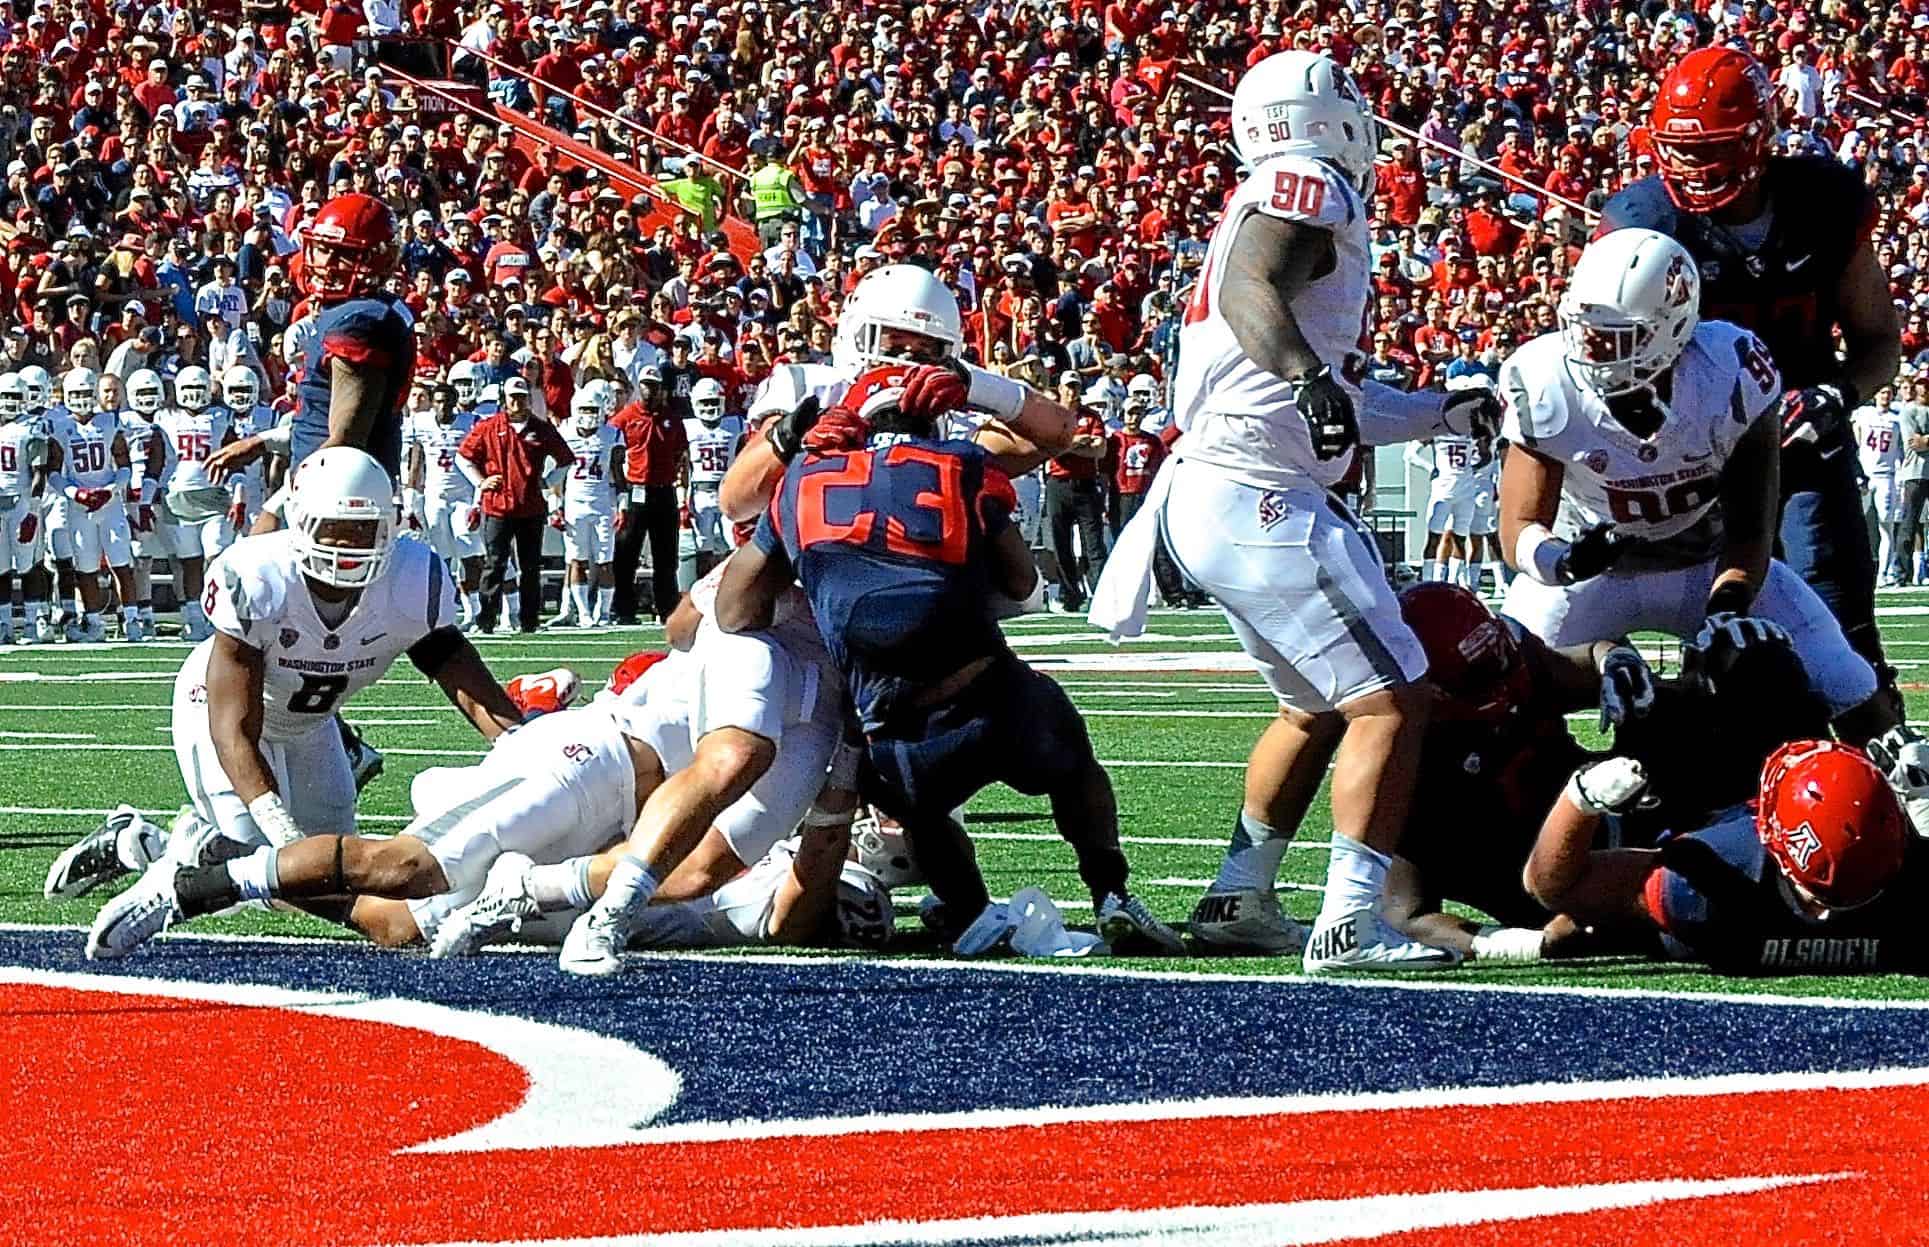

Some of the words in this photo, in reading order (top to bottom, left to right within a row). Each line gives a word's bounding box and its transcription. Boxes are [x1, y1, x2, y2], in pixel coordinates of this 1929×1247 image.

[1267, 120, 1291, 142] 90
[1271, 170, 1325, 217] 90
[177, 433, 212, 462] 95
[1866, 429, 1893, 453] 46
[71, 441, 105, 473] 50
[437, 448, 453, 473] 4
[573, 455, 604, 480] 24
[697, 446, 729, 471] 35
[1447, 444, 1467, 470] 15
[797, 446, 968, 562] 23
[204, 578, 219, 616] 8
[278, 657, 345, 673] WASHINGTON
[346, 656, 377, 672] STATE
[286, 671, 350, 713] 8
[1192, 894, 1243, 923] NIKE
[1310, 918, 1360, 961] NIKE
